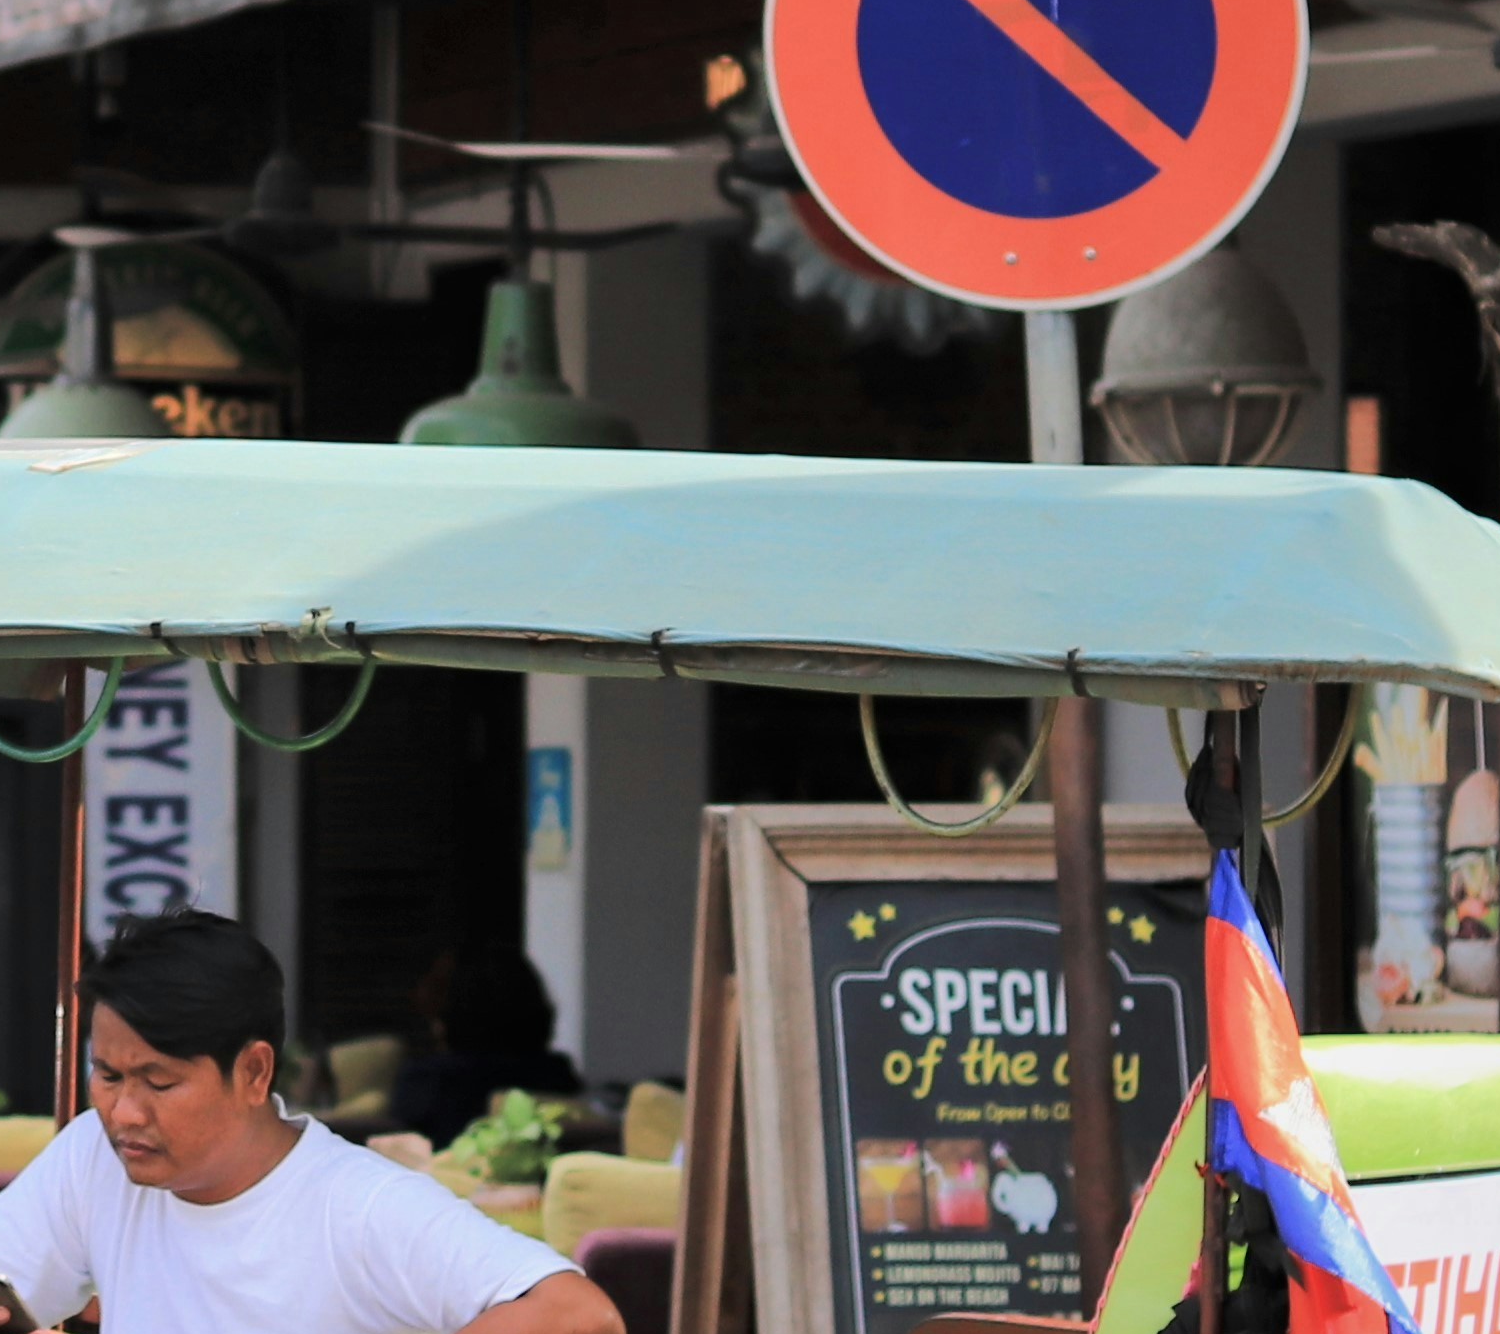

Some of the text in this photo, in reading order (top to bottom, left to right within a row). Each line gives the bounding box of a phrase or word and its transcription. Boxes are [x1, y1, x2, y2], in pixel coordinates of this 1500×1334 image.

[104, 660, 191, 772] NEY
[897, 966, 1121, 1037] SPECI
[882, 1035, 947, 1100] of
[958, 1037, 1039, 1086] the
[1031, 1102, 1050, 1120] to
